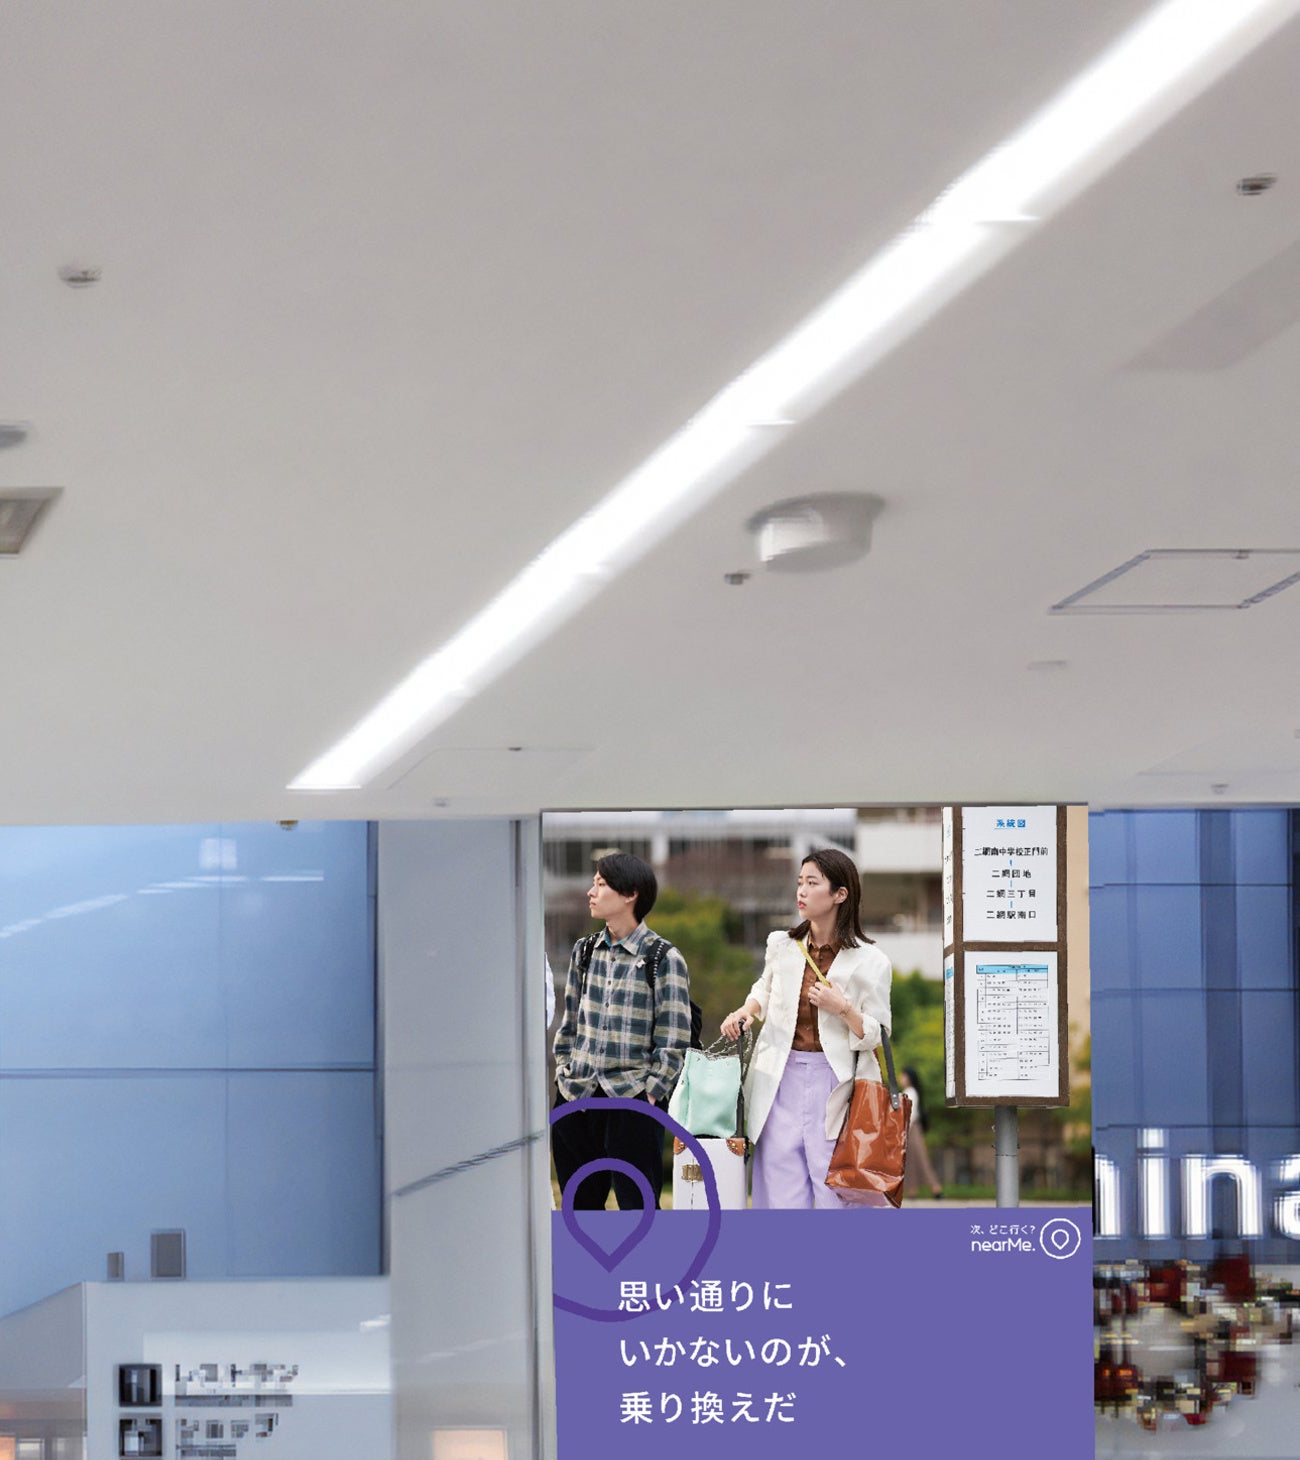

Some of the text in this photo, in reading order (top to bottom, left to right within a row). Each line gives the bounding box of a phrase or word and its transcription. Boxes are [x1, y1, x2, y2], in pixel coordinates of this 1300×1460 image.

[971, 1237, 1036, 1252] nearMe.
[617, 1279, 793, 1313] 思い通りに
[620, 1333, 846, 1368] いかないのが、
[619, 1390, 797, 1425] 乗り換えだ
